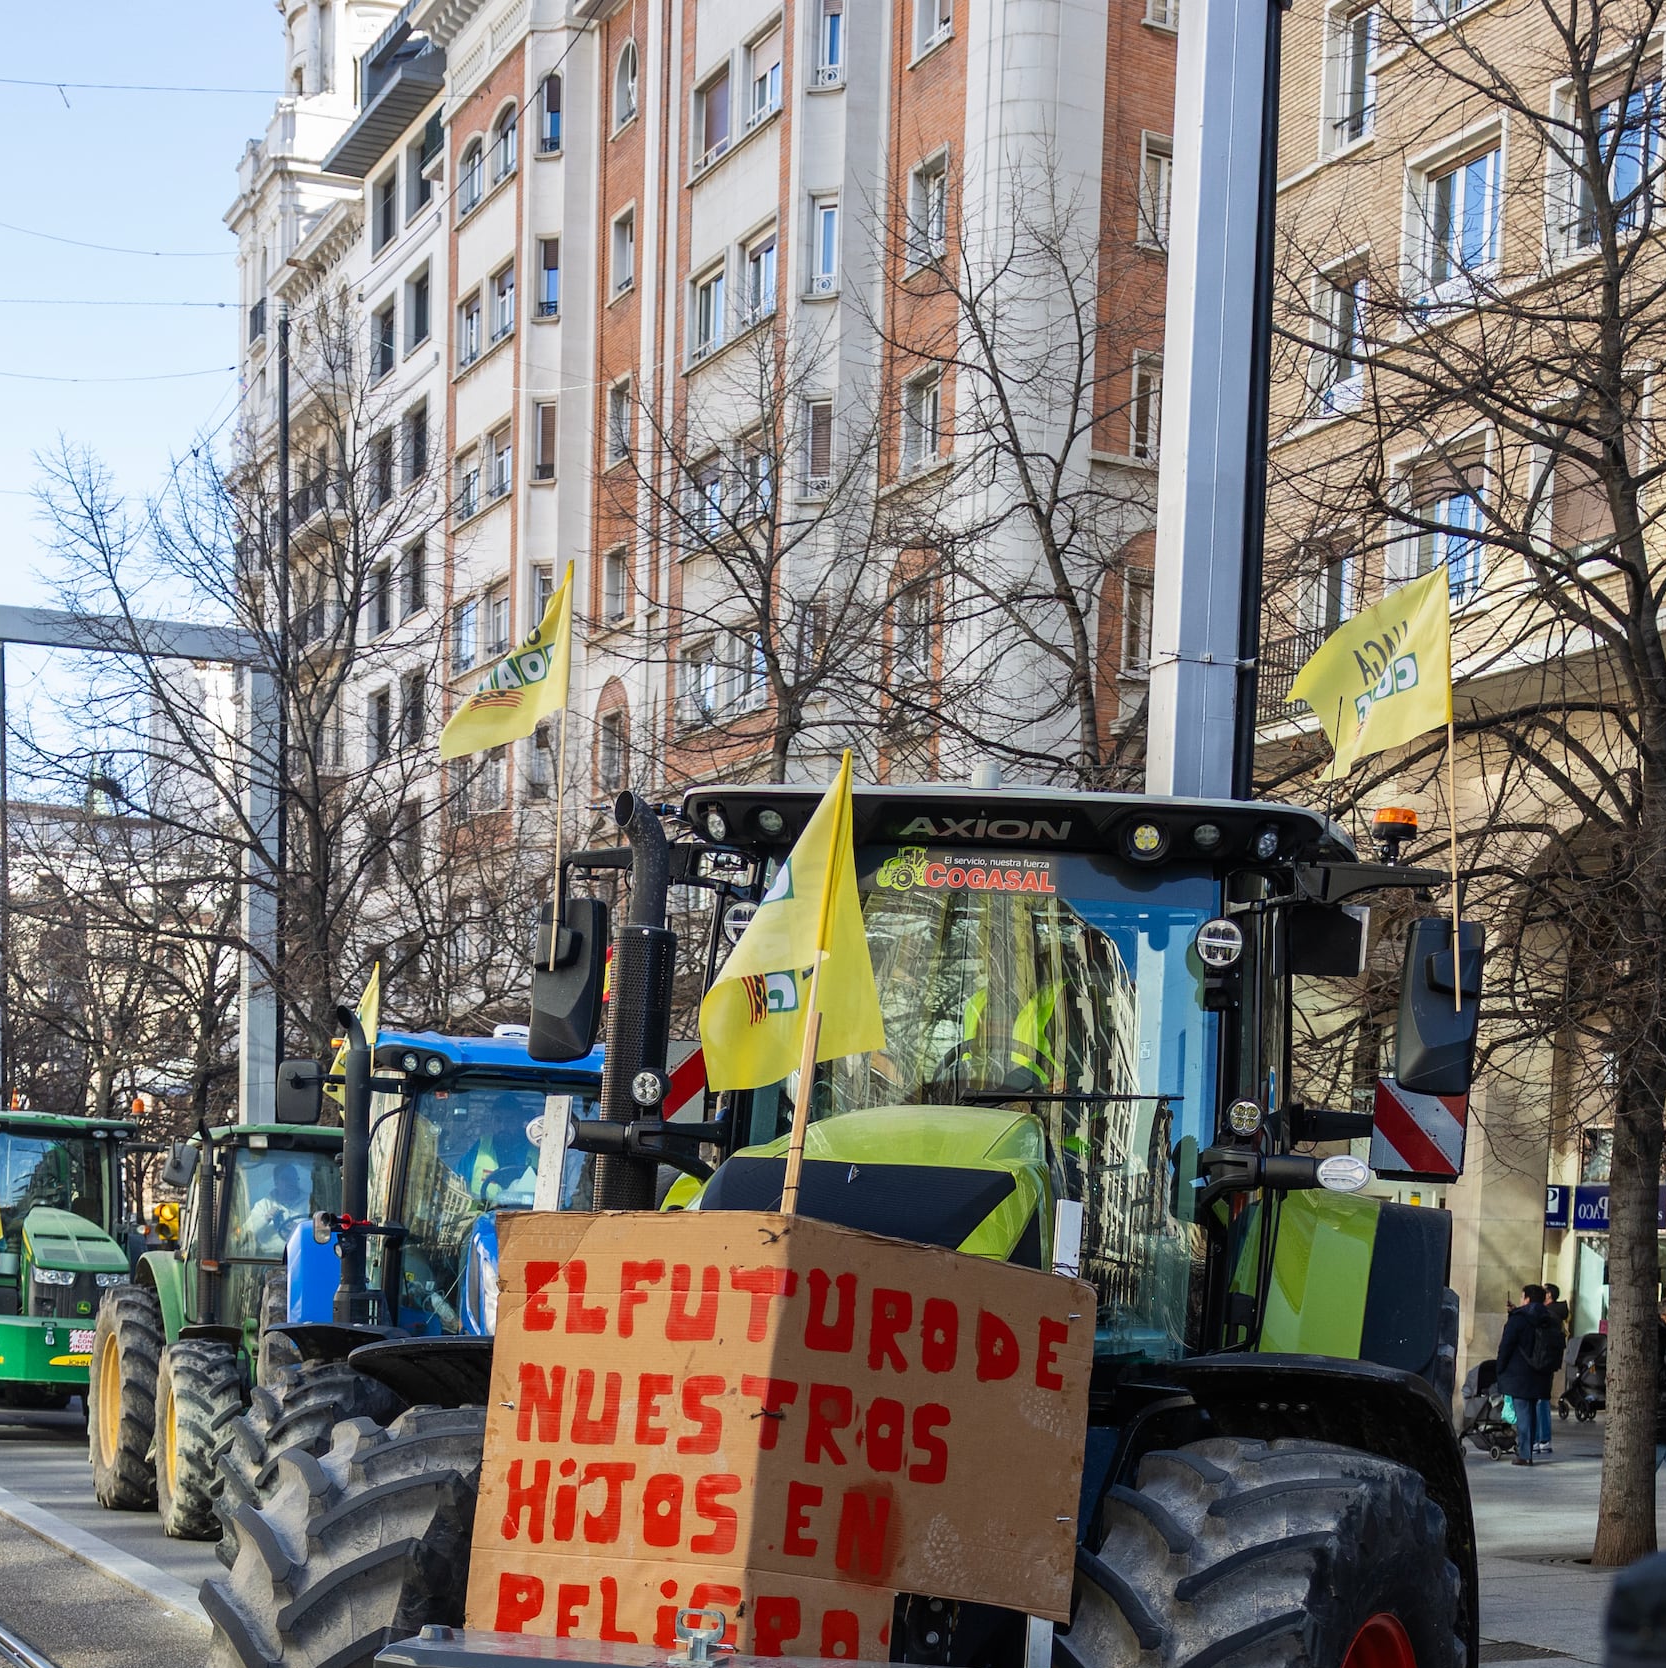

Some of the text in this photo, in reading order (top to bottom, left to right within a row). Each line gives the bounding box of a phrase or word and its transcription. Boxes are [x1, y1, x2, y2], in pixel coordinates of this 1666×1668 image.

[899, 816, 1072, 841] AXION
[924, 862, 1056, 893] COGASAL
[944, 856, 1050, 869] El servicio, nuestra fuerza
[516, 1361, 952, 1485] NUESTROS
[782, 1480, 895, 1577] EN
